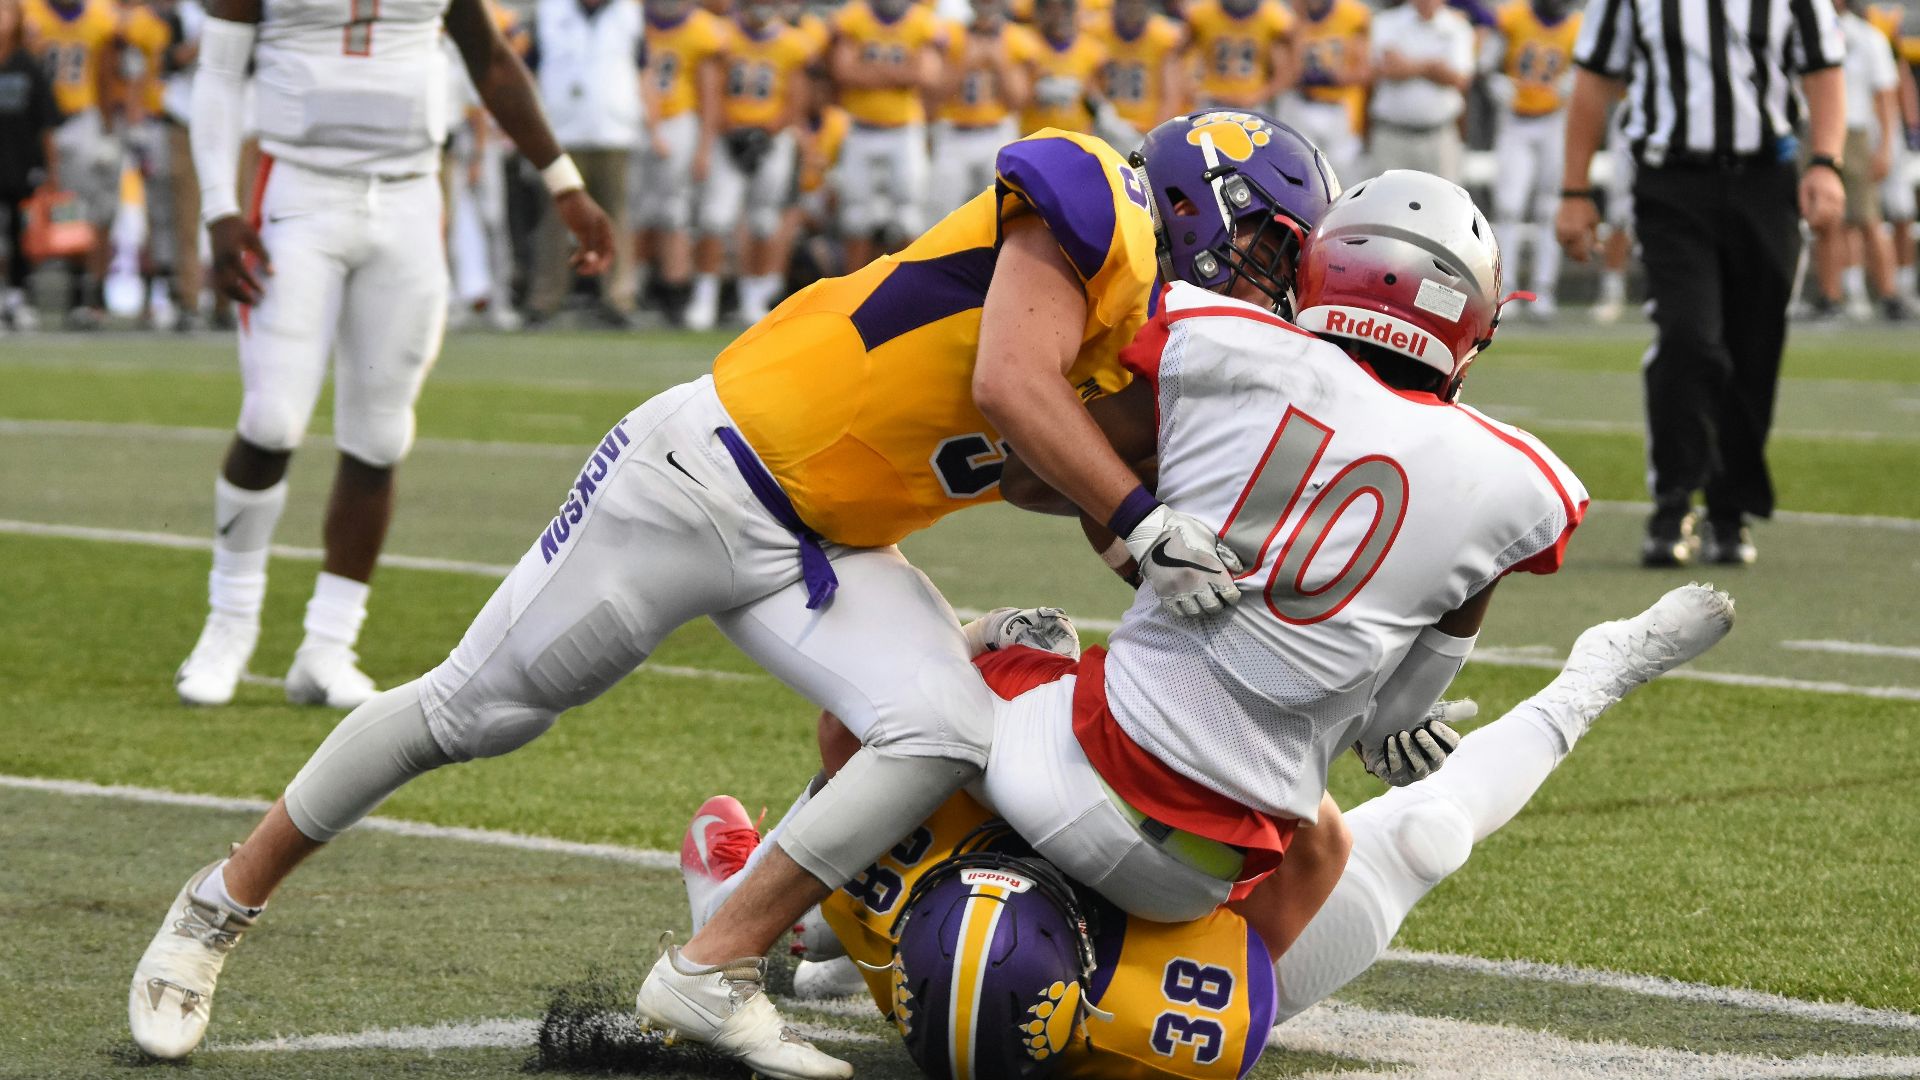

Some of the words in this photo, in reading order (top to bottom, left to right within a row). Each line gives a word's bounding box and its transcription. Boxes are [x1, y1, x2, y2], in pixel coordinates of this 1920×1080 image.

[1326, 309, 1429, 358] Riddell
[540, 417, 631, 565] JACKSON
[1218, 402, 1410, 626] 10
[967, 871, 1022, 888] Riddell
[1149, 956, 1237, 1065] 38
